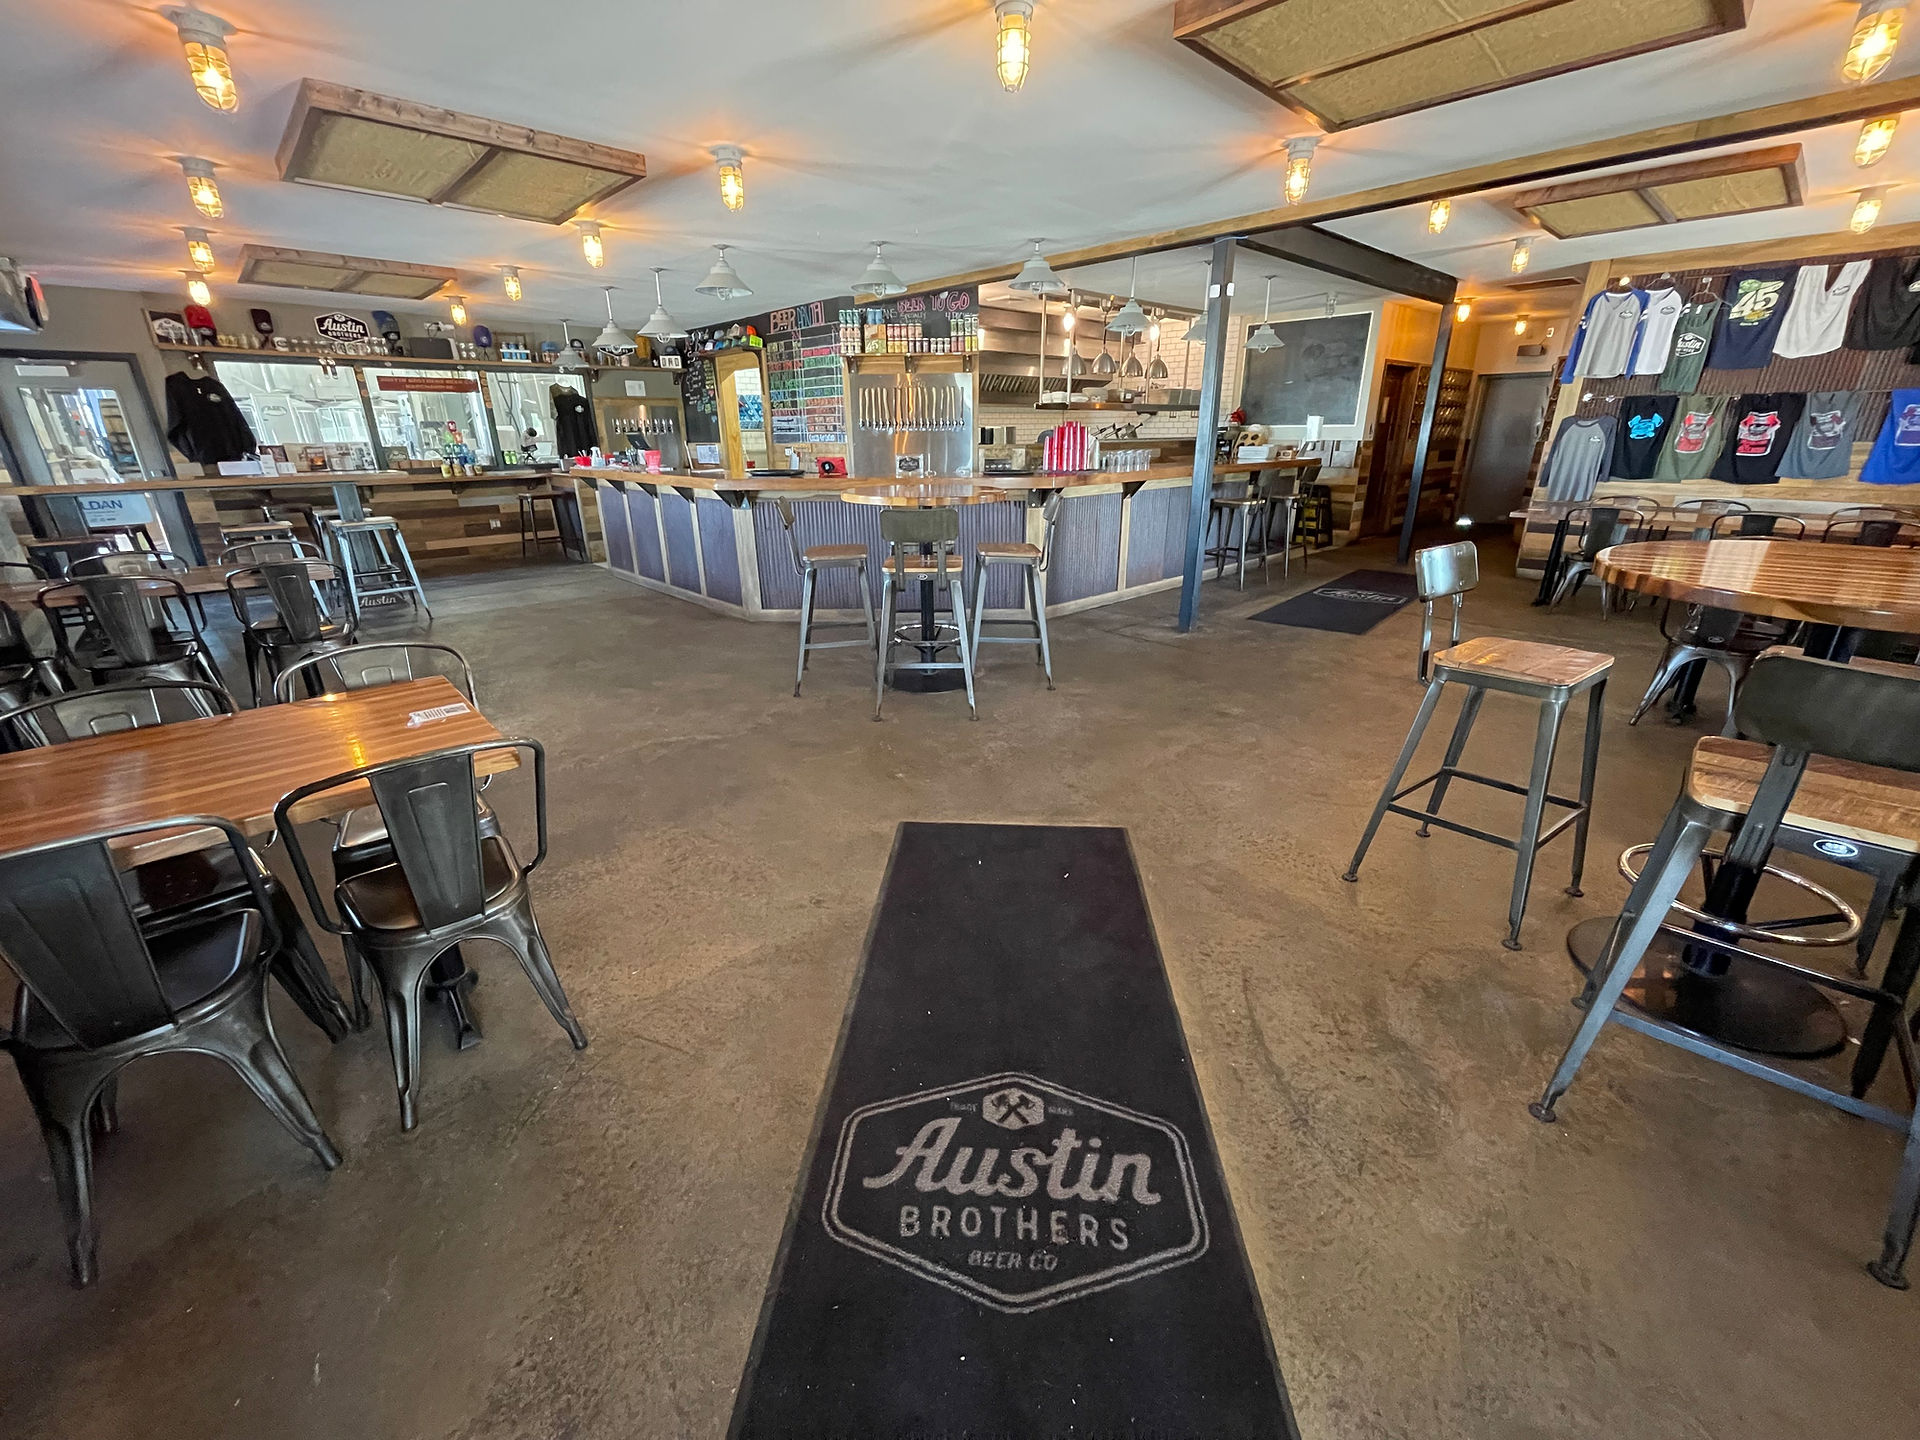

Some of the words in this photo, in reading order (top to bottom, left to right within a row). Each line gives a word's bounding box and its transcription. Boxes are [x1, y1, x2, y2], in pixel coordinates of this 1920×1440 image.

[946, 291, 970, 312] GO
[1729, 281, 1784, 319] 45
[320, 318, 365, 333] Austin
[359, 595, 397, 607] Austin
[863, 1117, 1161, 1206] Austin
[899, 1204, 1130, 1251] BROTHERS
[968, 1249, 1023, 1271] BEER
[1029, 1250, 1059, 1272] CO
